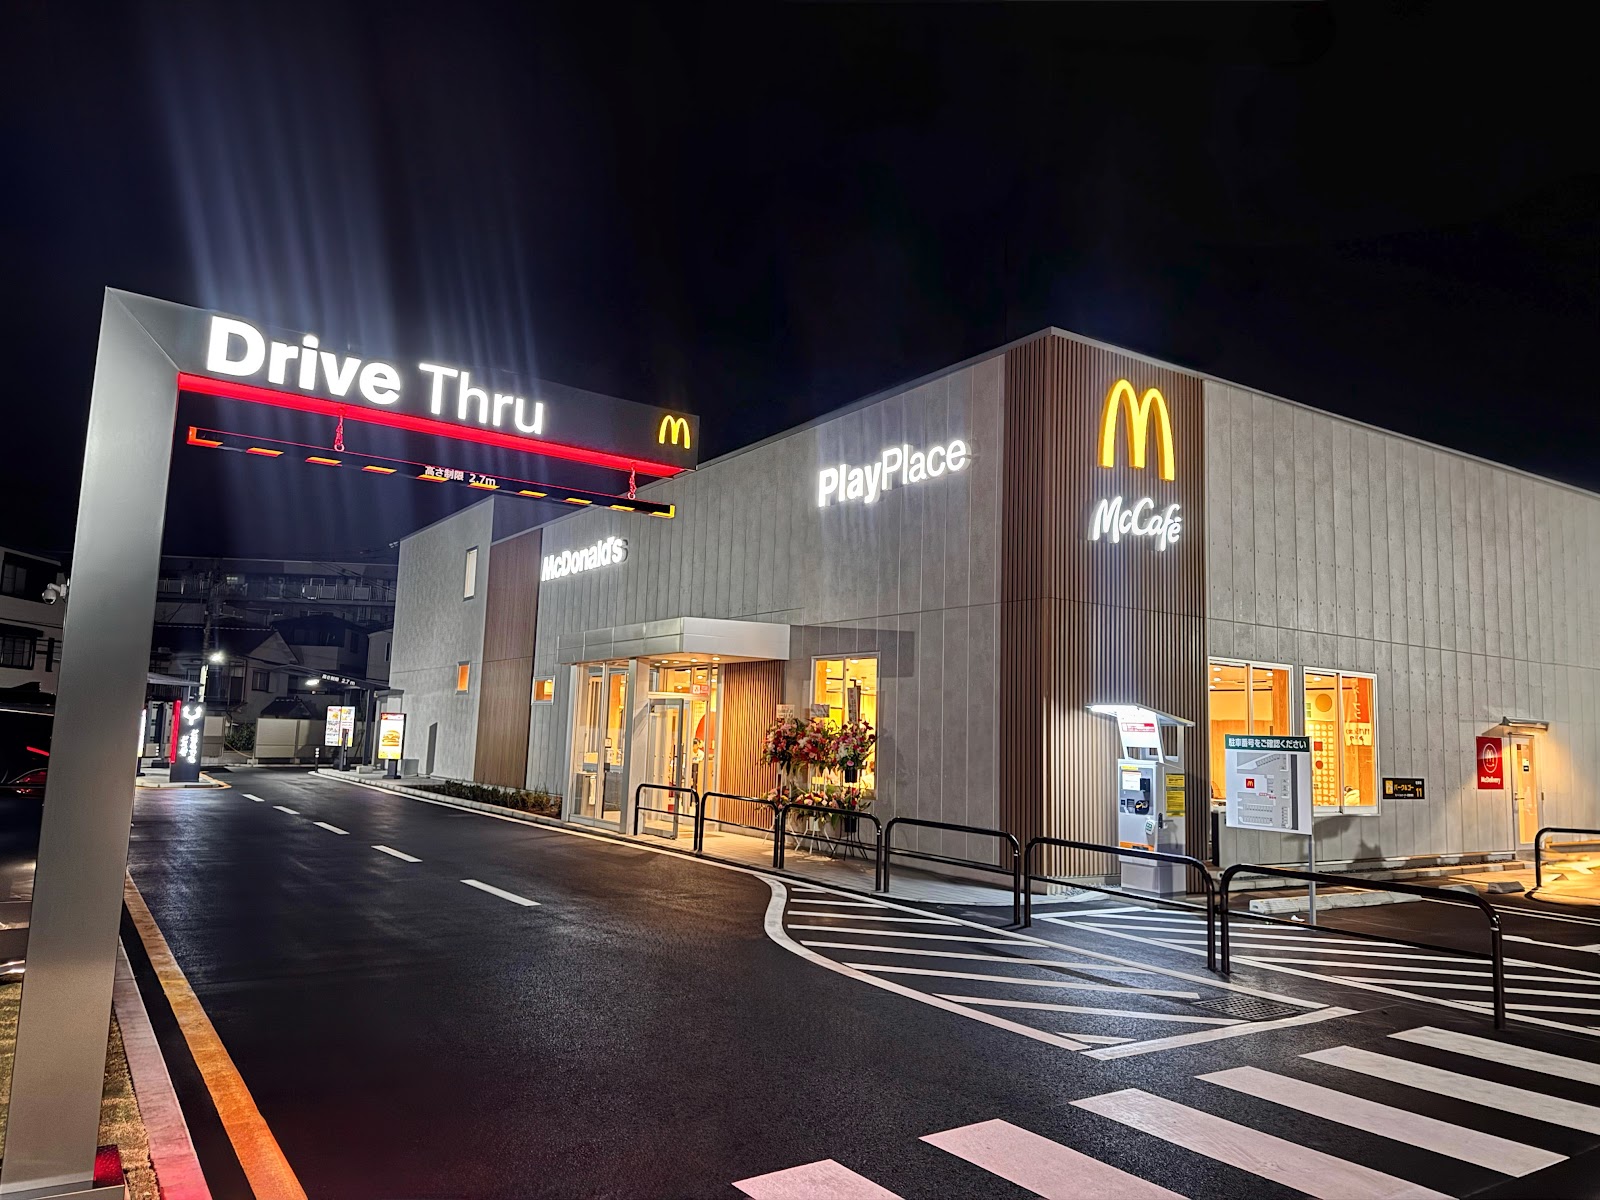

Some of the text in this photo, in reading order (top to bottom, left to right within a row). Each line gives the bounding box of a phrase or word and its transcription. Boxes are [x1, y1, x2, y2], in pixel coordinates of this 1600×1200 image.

[207, 315, 544, 435] Drive Thru
[424, 465, 497, 487] 高さ制限 2.7m
[818, 440, 970, 508] PlayPlace
[1092, 496, 1182, 552] McCafé
[541, 536, 624, 582] McDonald's
[1228, 737, 1307, 750] 駐車番号をご確認ください
